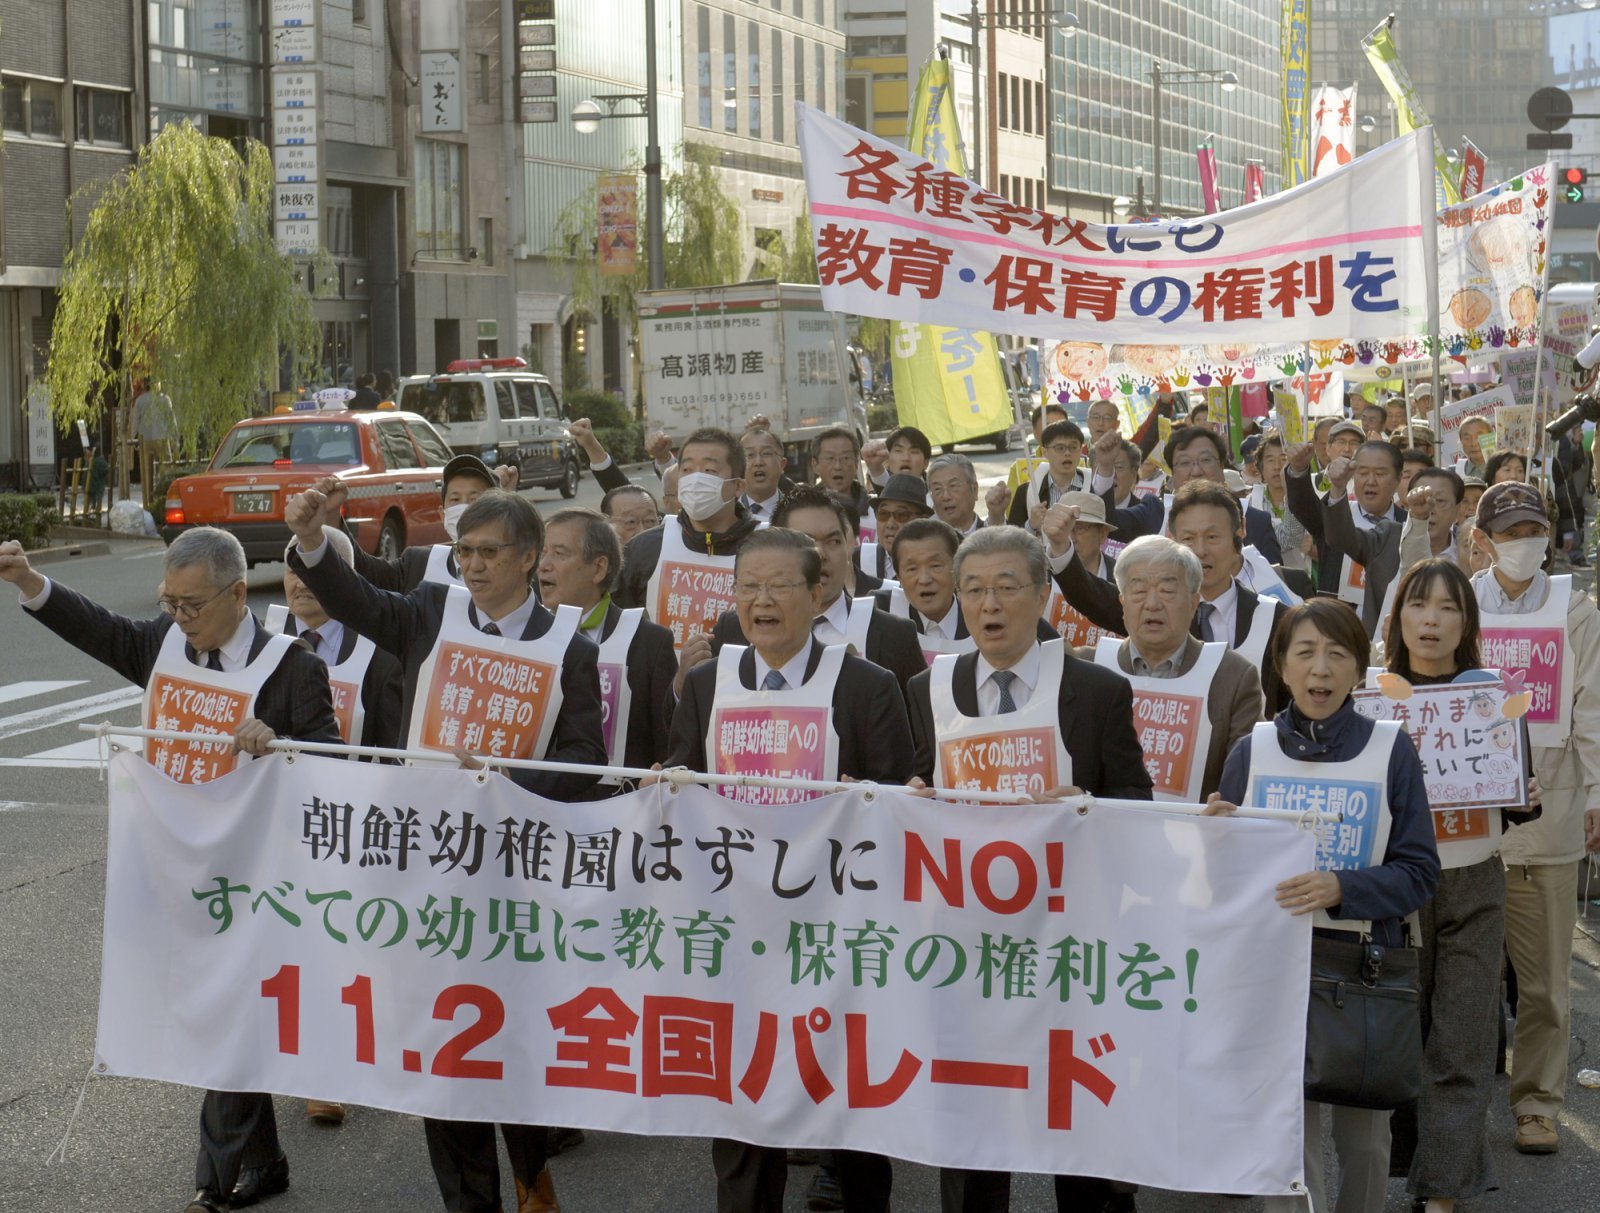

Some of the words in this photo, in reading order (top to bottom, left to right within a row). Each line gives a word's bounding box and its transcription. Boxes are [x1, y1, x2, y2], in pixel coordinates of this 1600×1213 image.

[280, 193, 315, 206] 快復堂
[817, 222, 1400, 324] 教育・保育の権利を
[1440, 416, 1461, 432] Never
[671, 567, 736, 597] すべての幼児
[669, 620, 714, 644] 権利
[449, 650, 543, 694] すべての幼児に
[160, 682, 239, 723] すべての幼児に
[440, 681, 533, 727] 教育・保育の
[1391, 698, 1467, 724] なかま
[155, 714, 228, 755] 教育保育の
[439, 715, 520, 758] 権利を!
[721, 719, 819, 756] 朝鮮幼稚園への
[951, 736, 1044, 776] すべての幼児に
[1265, 783, 1368, 821] 前代未聞の
[301, 795, 879, 899] 朝鮮幼稚園はずしに
[903, 831, 1065, 915] NO!
[192, 876, 1200, 1013] すべての幼児に教育・保育の権利を!
[261, 964, 506, 1081] 11.2
[545, 986, 1117, 1131] 全国パレード
